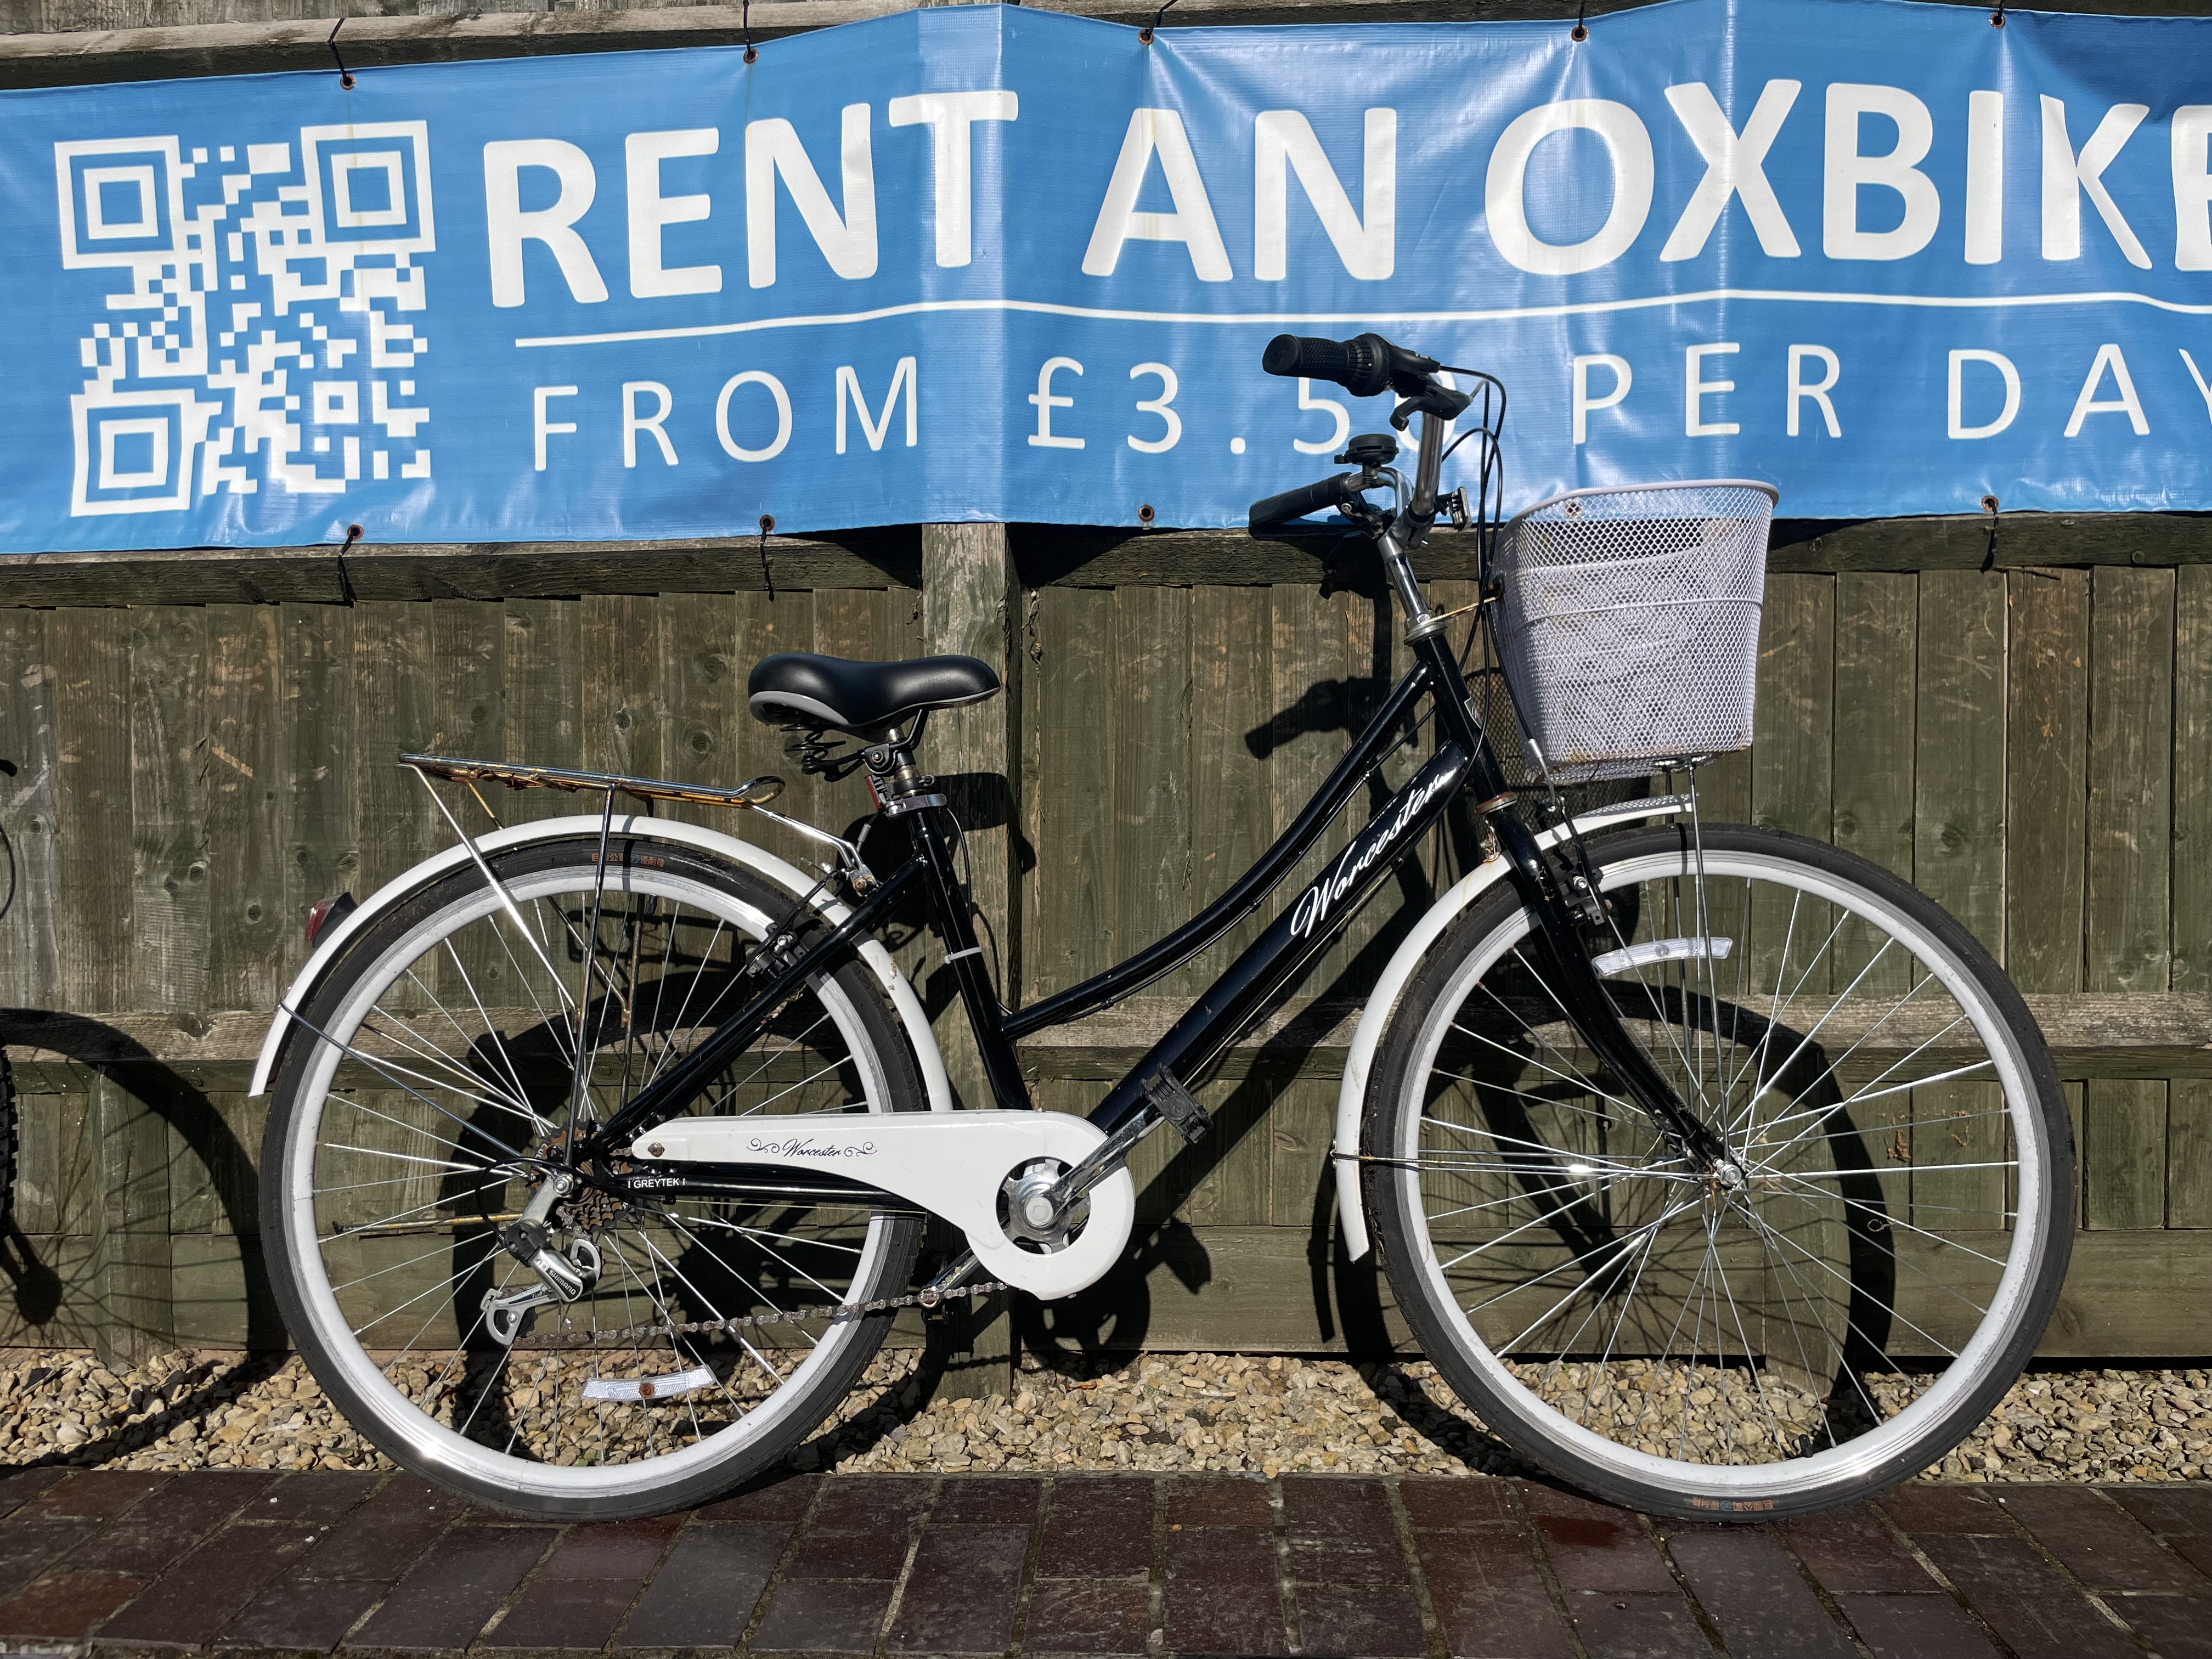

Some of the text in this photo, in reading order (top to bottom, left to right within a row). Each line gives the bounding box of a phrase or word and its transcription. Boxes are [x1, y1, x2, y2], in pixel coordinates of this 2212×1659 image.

[484, 90, 1018, 308] RENT
[1081, 108, 1397, 281] AN
[534, 356, 917, 471] FROM
[1572, 342, 1842, 445] PER
[1290, 774, 1442, 937] Worcester
[634, 1178, 680, 1188] GREYTEK
[782, 1138, 842, 1157] Worcester
[549, 1269, 576, 1295] SHIMANO
